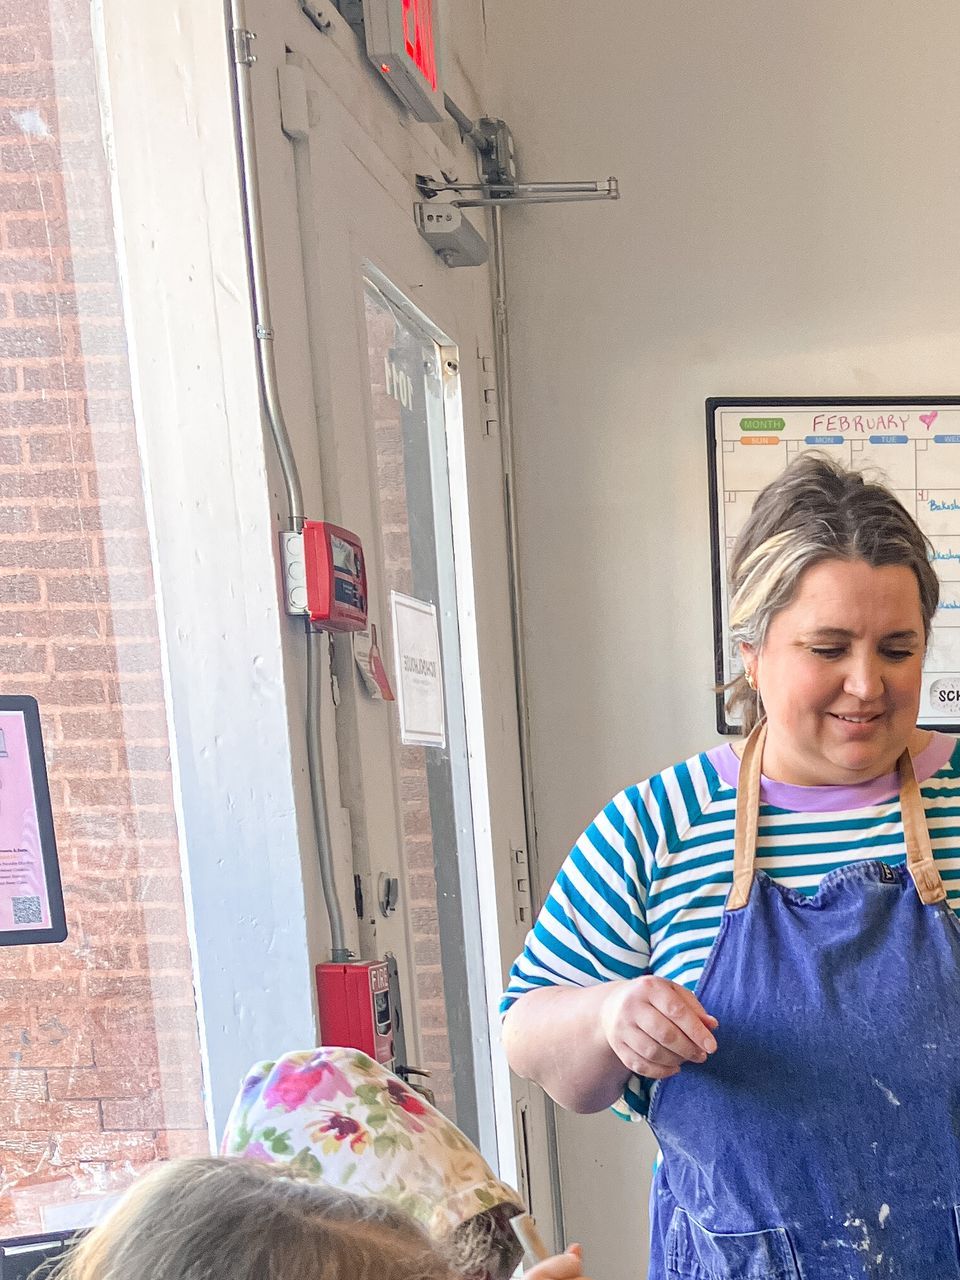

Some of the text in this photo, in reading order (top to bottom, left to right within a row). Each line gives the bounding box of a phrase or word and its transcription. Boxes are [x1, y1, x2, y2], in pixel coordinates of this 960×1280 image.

[745, 420, 781, 429] MONTH
[813, 414, 910, 433] FEBRUARY
[371, 967, 389, 990] FIRE
